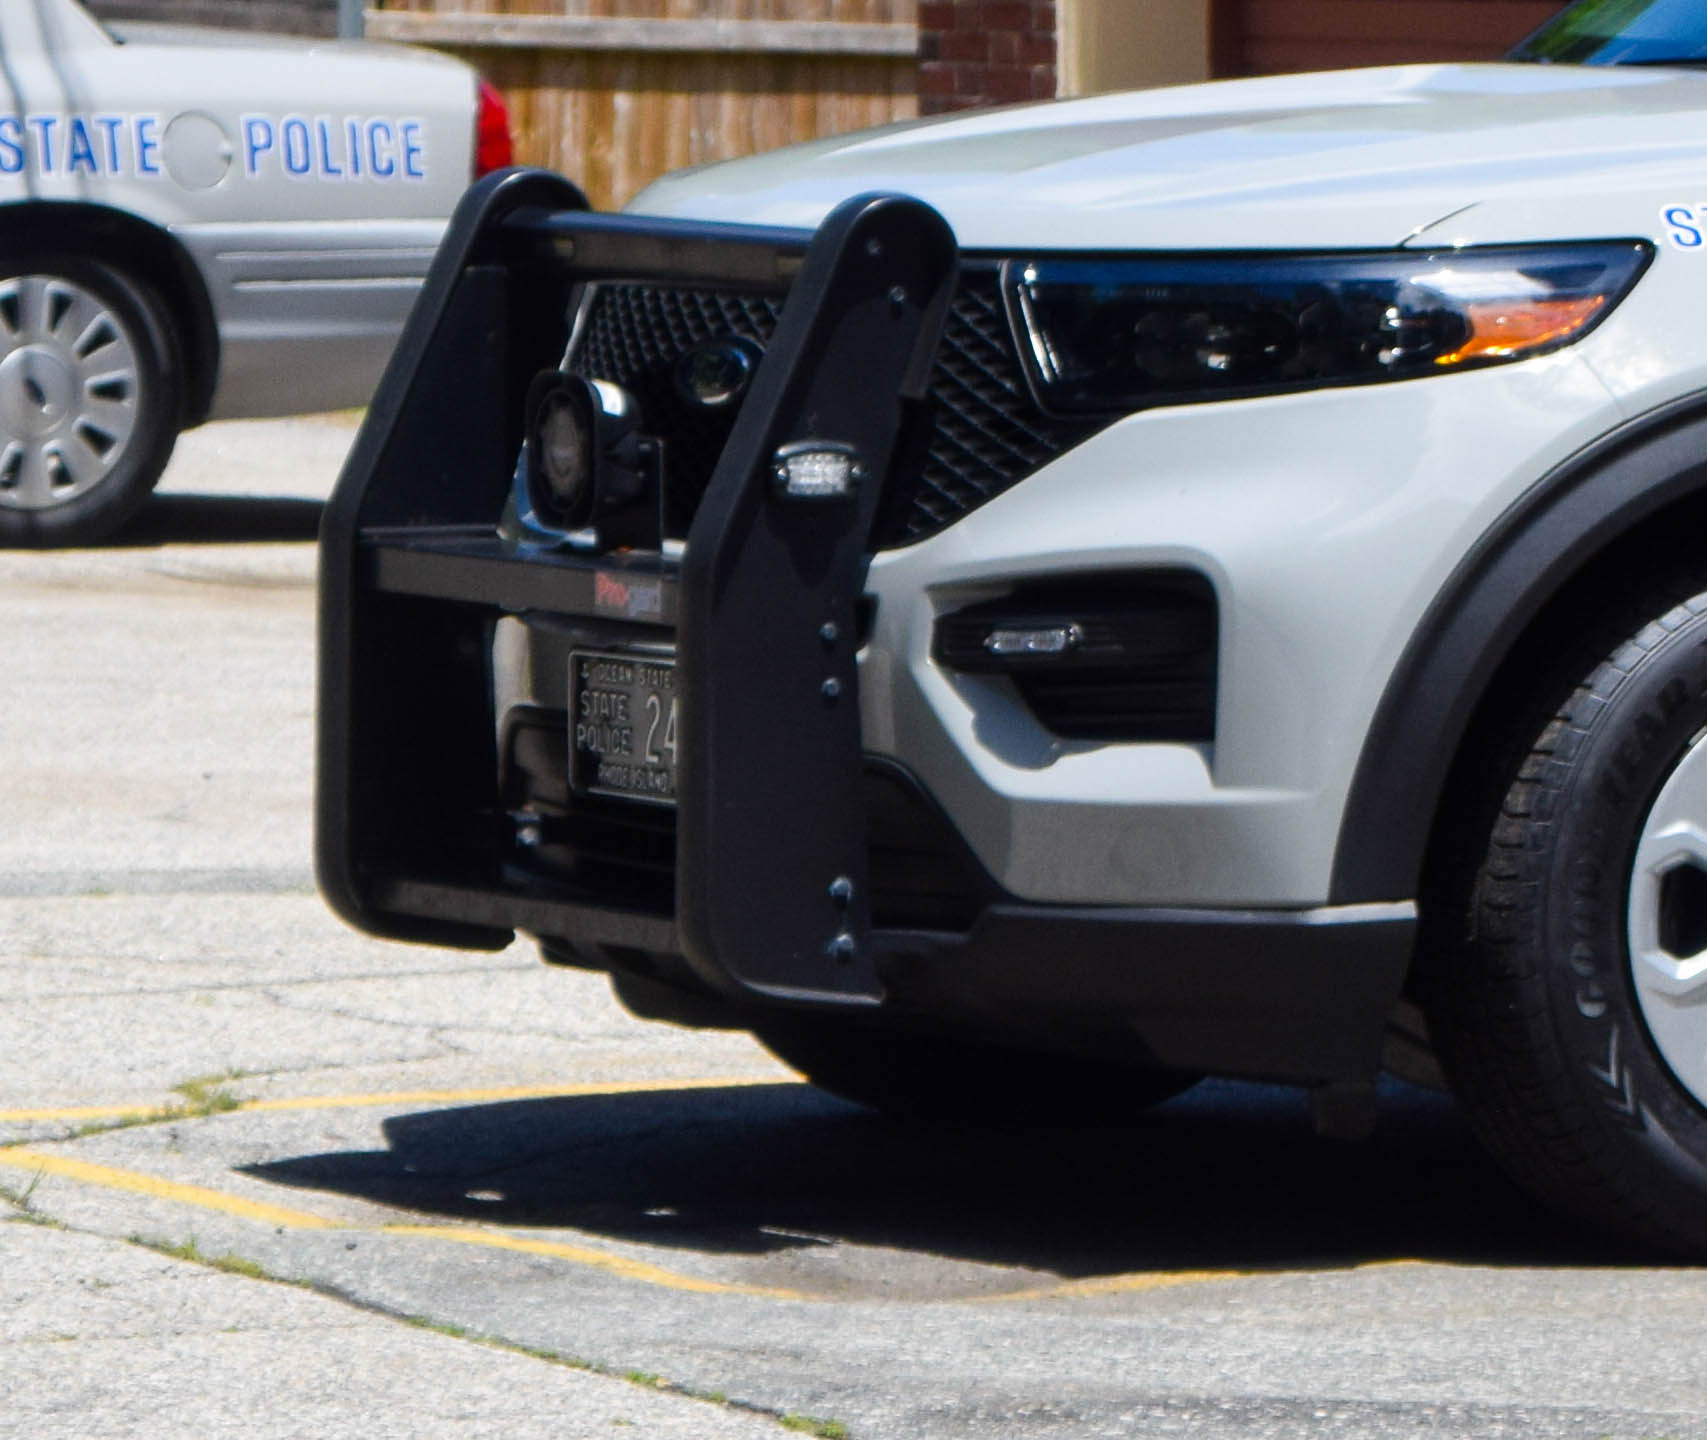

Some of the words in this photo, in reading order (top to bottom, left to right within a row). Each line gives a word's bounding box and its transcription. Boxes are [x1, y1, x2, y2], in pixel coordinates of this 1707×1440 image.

[0, 116, 161, 174] STATE
[241, 118, 424, 178] POLICE
[580, 690, 629, 721] STATE
[577, 723, 632, 756] POLICE
